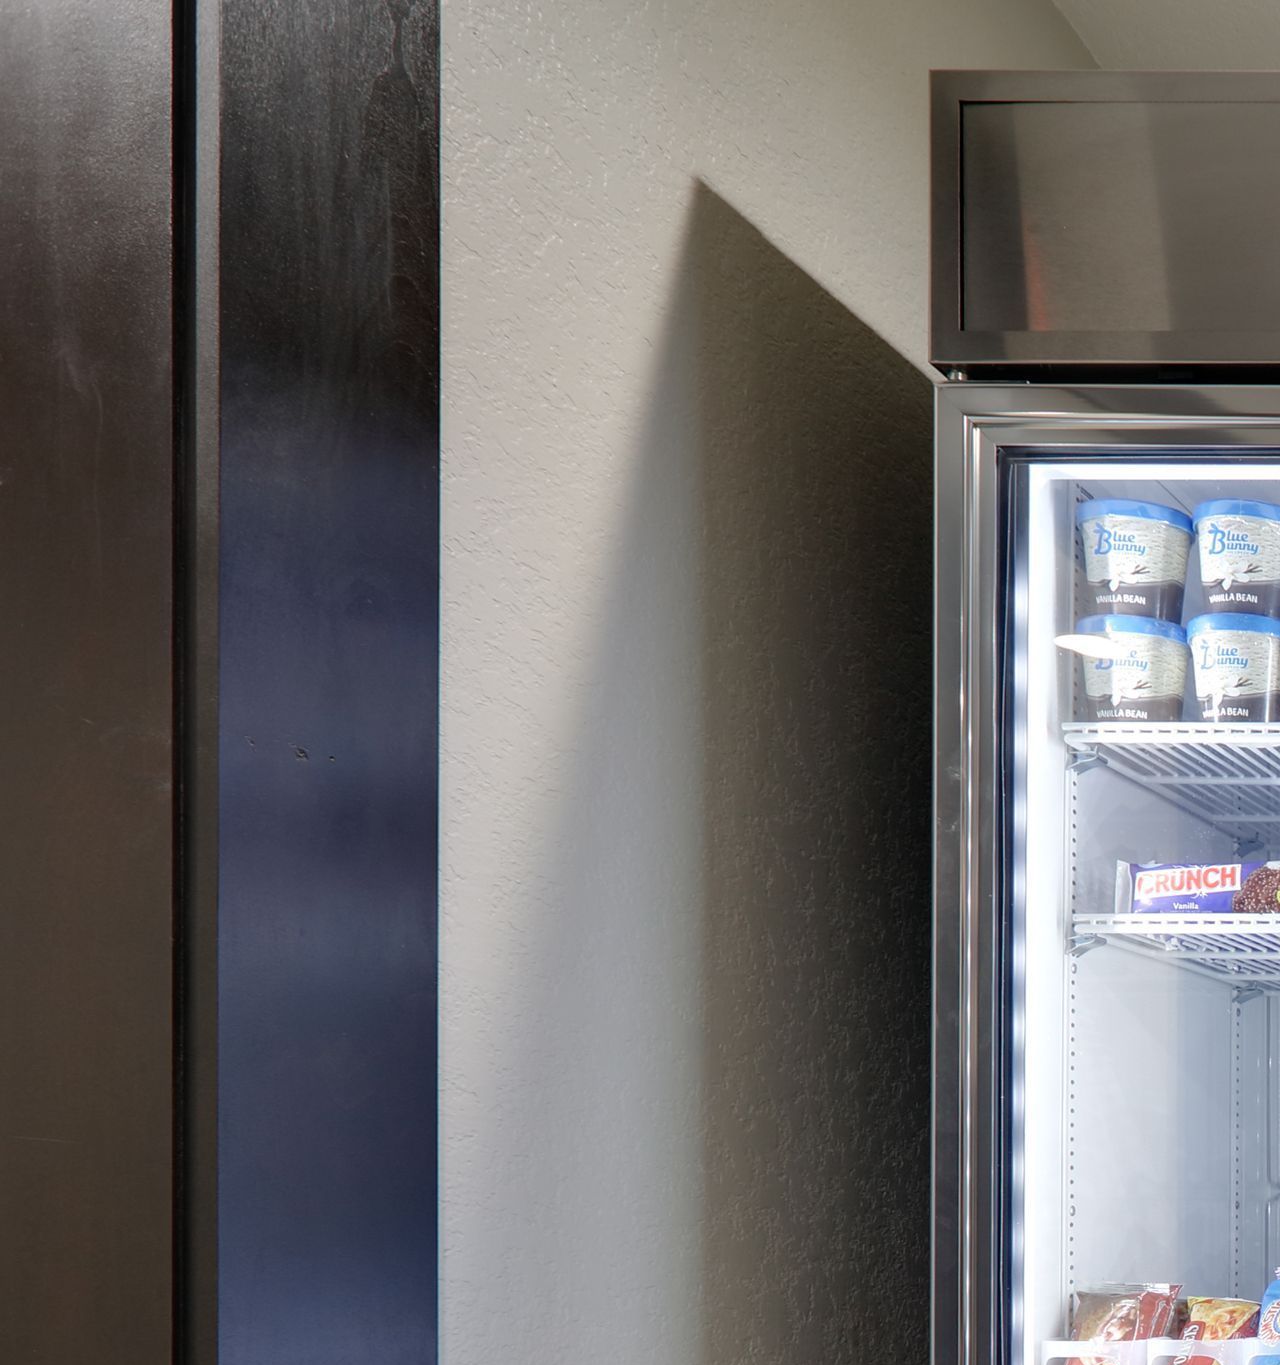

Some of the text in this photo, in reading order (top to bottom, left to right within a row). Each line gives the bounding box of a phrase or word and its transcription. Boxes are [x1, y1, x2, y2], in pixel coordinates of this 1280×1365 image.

[1123, 594, 1146, 605] BEAN
[1236, 593, 1258, 604] BEAN
[1125, 708, 1148, 719] BEAN
[1227, 707, 1249, 718] BEAN
[1137, 866, 1236, 894] CRUNCH
[1173, 902, 1199, 910] Vanilla
